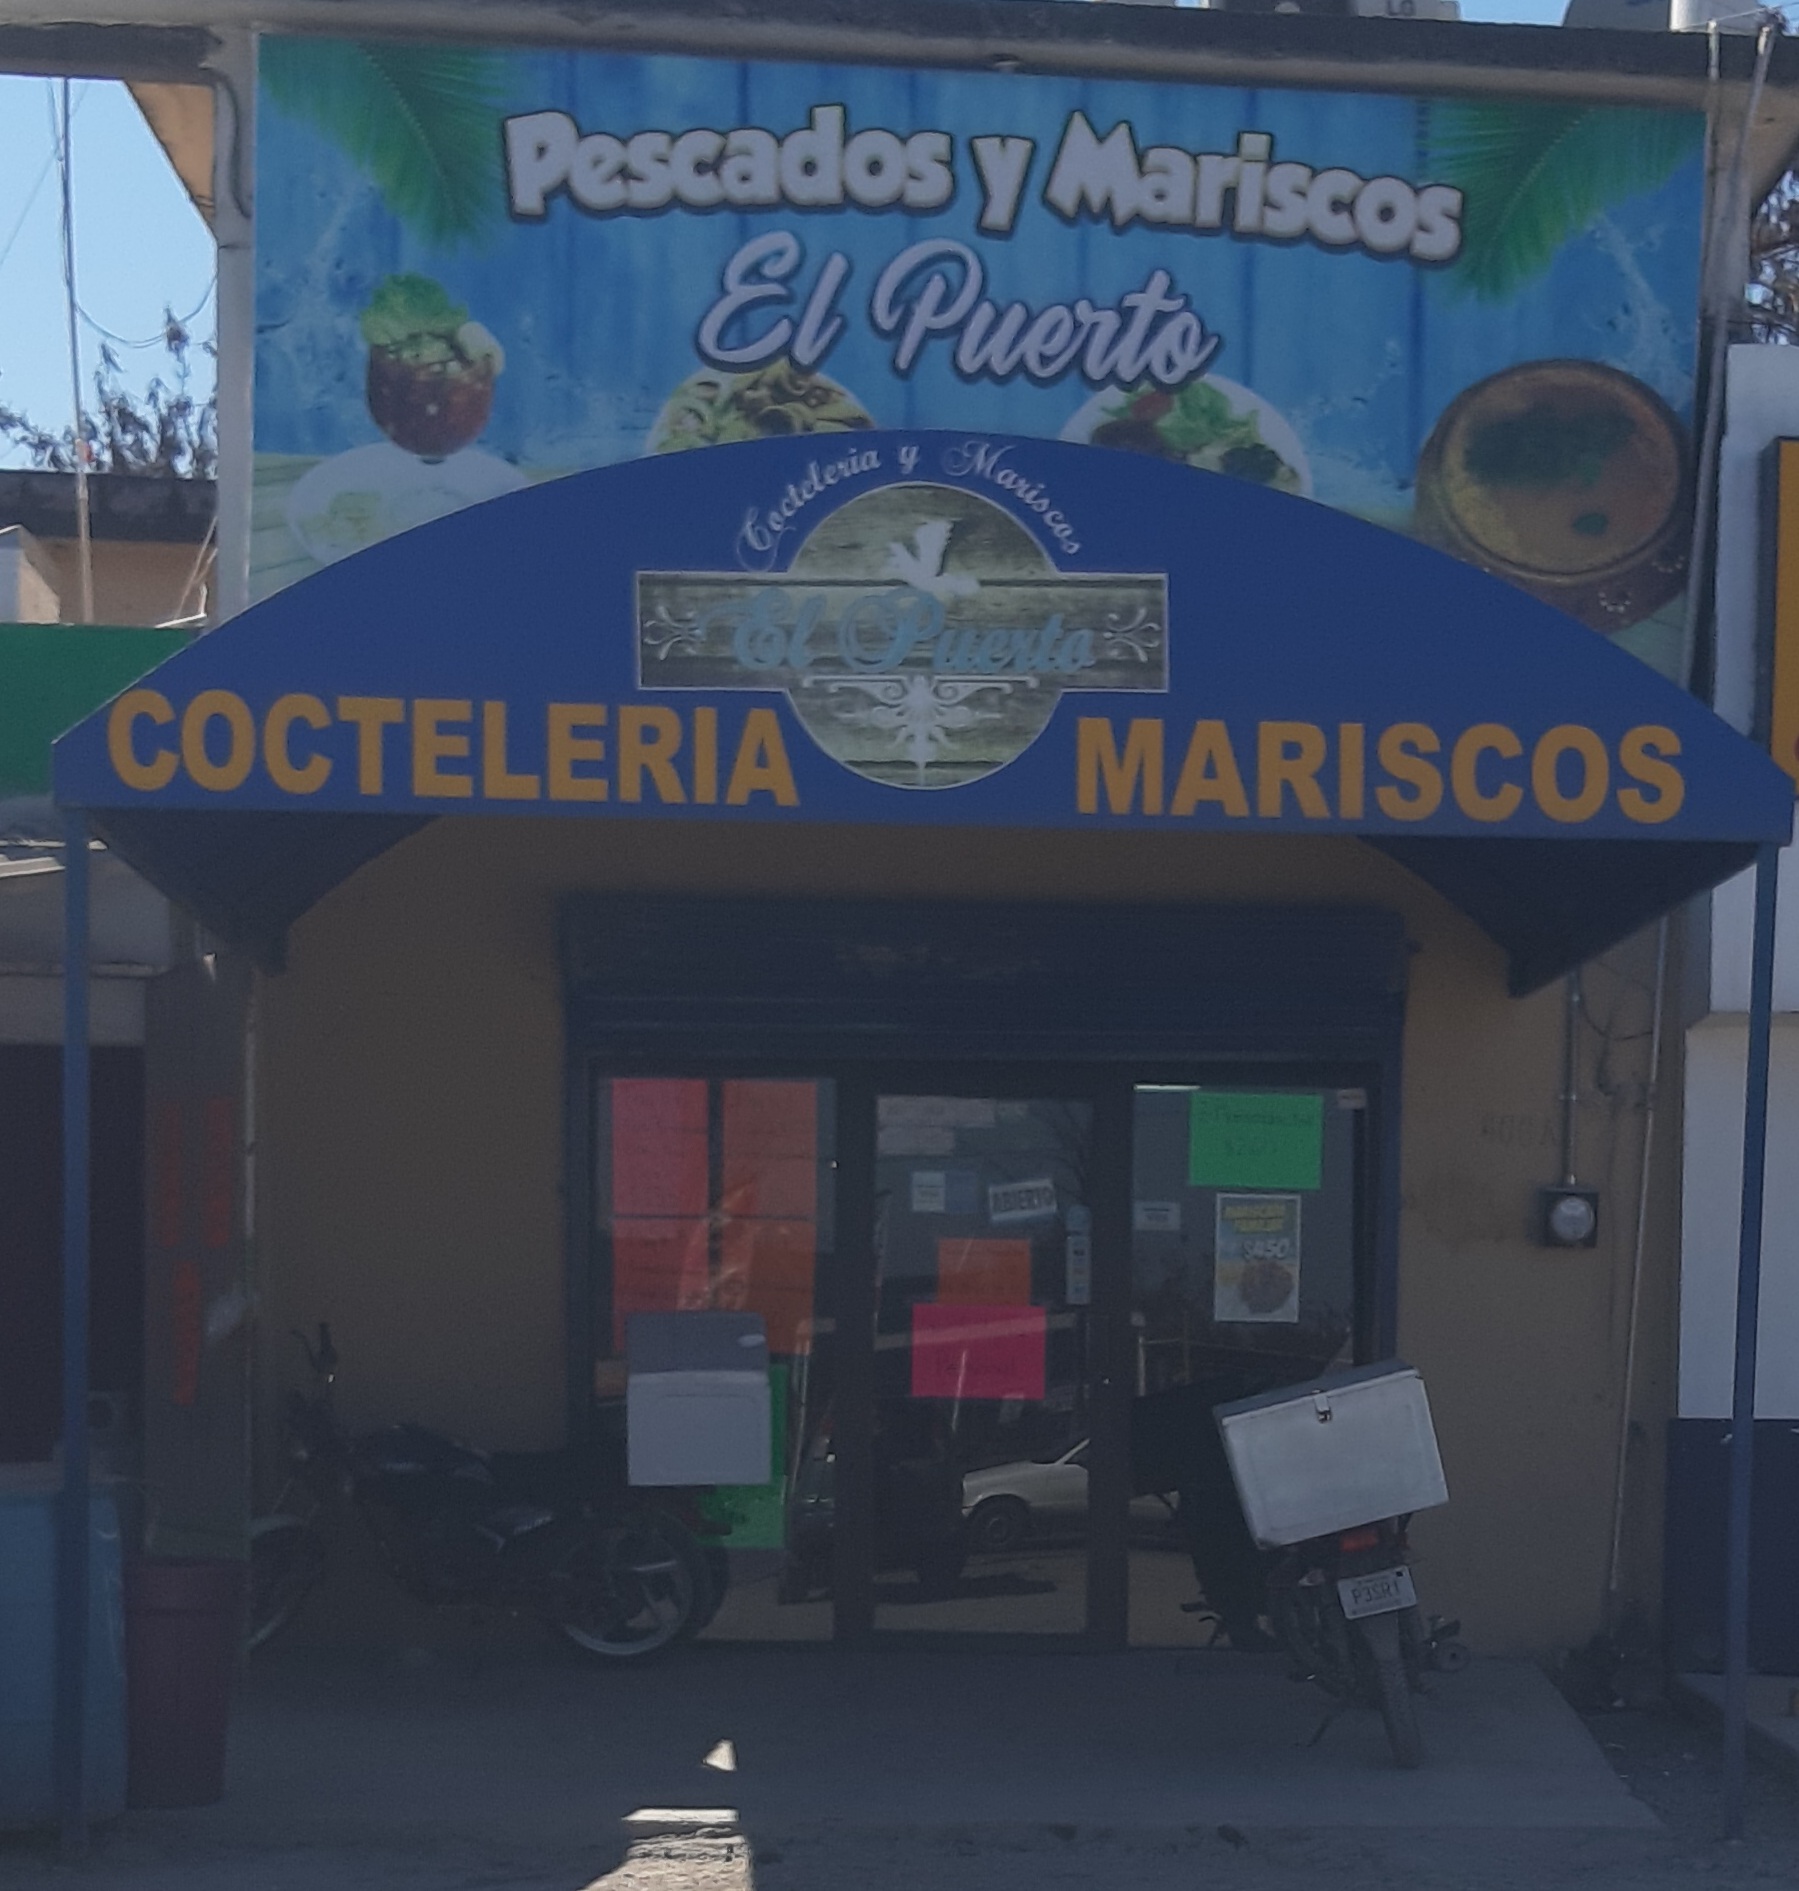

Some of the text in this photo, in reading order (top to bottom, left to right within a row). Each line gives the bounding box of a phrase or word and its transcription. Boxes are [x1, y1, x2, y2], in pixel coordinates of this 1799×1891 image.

[503, 103, 954, 219] Pescados
[1043, 109, 1464, 264] Mariscos
[699, 230, 1219, 386] El Puerto
[897, 444, 919, 475] y
[941, 440, 1081, 555] Mariscos
[697, 584, 1097, 674] El Puerto
[107, 689, 1686, 825] COCTELERIA MARISCOS
